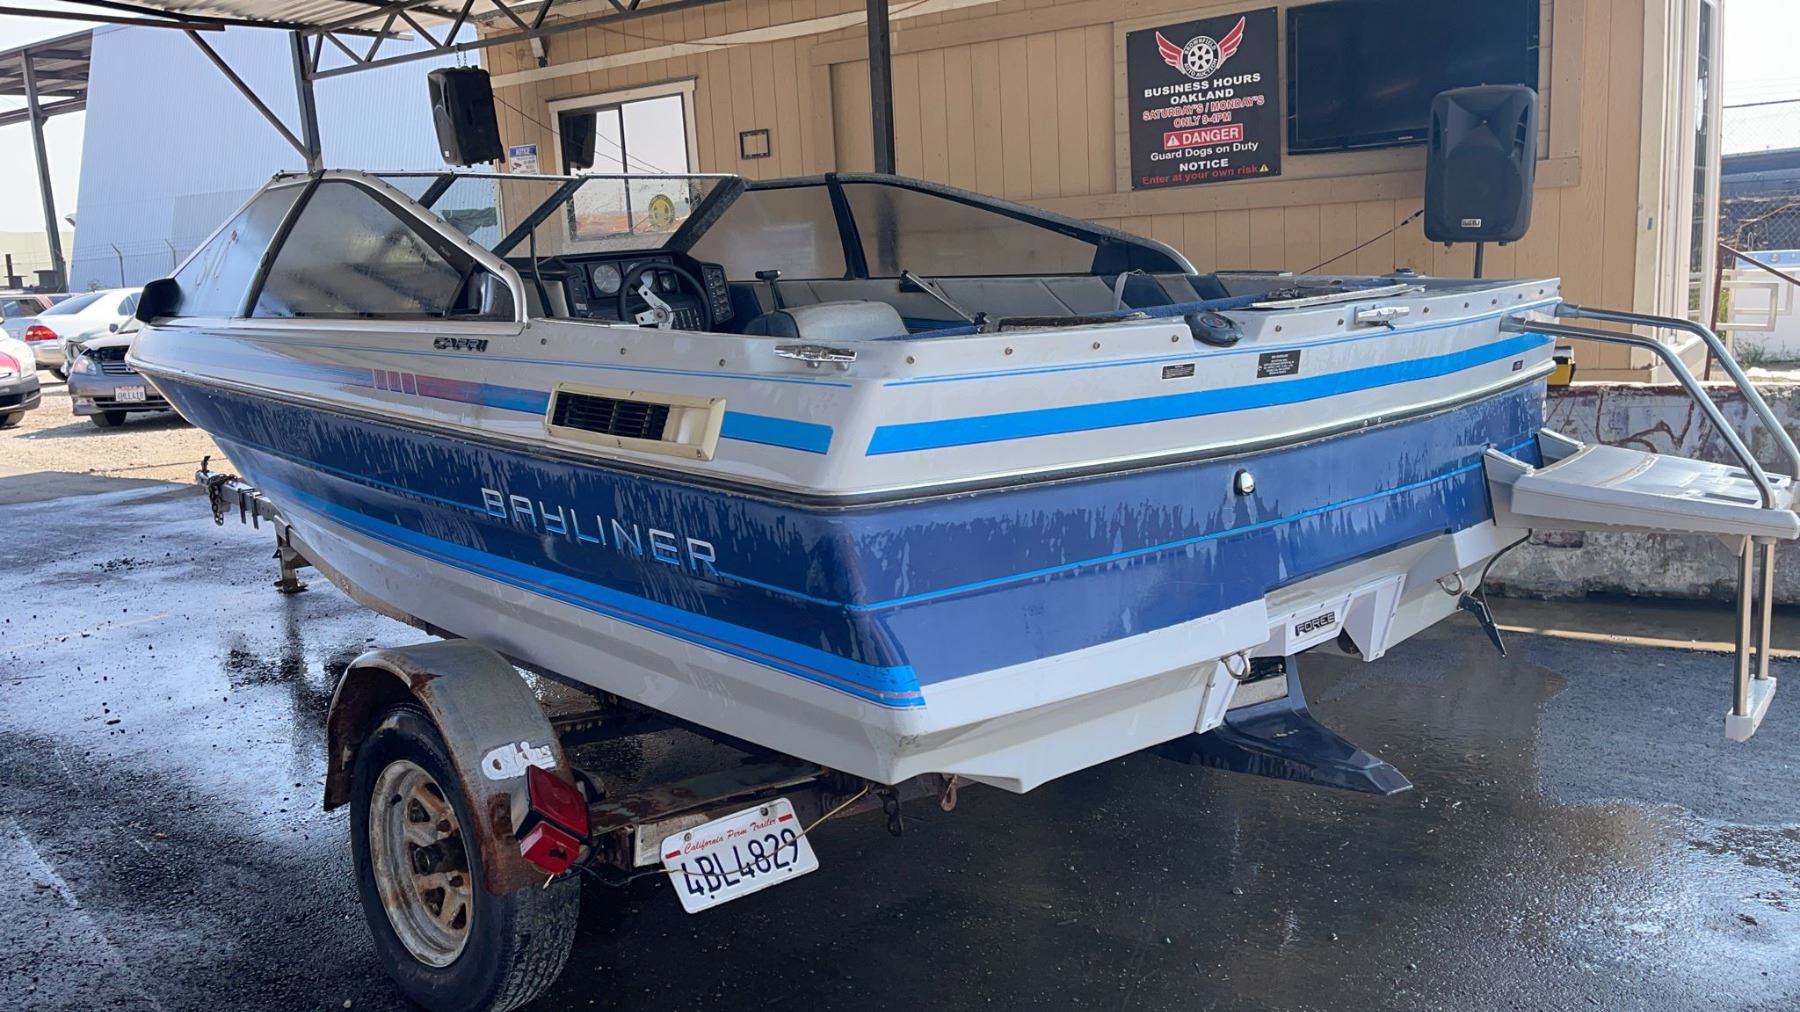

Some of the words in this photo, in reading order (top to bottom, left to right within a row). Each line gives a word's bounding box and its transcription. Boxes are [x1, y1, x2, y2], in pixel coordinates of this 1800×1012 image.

[1184, 63, 1196, 77] AUTO
[1195, 58, 1218, 78] AUCTION
[1144, 80, 1209, 98] BUSINESS
[1213, 73, 1261, 88] HOURS
[1170, 88, 1234, 105] OAKLAND
[1173, 115, 1201, 128] ONLY
[1201, 111, 1232, 125] 9-4PM
[1182, 127, 1239, 145] DANGER
[1150, 149, 1182, 161] Guard
[1185, 146, 1213, 157] Dogs
[1216, 145, 1230, 153] on
[1233, 141, 1259, 152] Duty
[1142, 175, 1169, 185] Enter
[1172, 174, 1182, 182] at
[1184, 171, 1208, 183] your
[1212, 169, 1234, 177] own
[1237, 164, 1258, 175] risk
[1179, 158, 1229, 172] NOTICE
[481, 487, 720, 577] BAYLINER
[1295, 611, 1335, 636] FORCE
[684, 835, 725, 855] California
[726, 828, 747, 840] Perm
[750, 818, 777, 831] Trailer
[680, 828, 798, 896] 4BL4829
